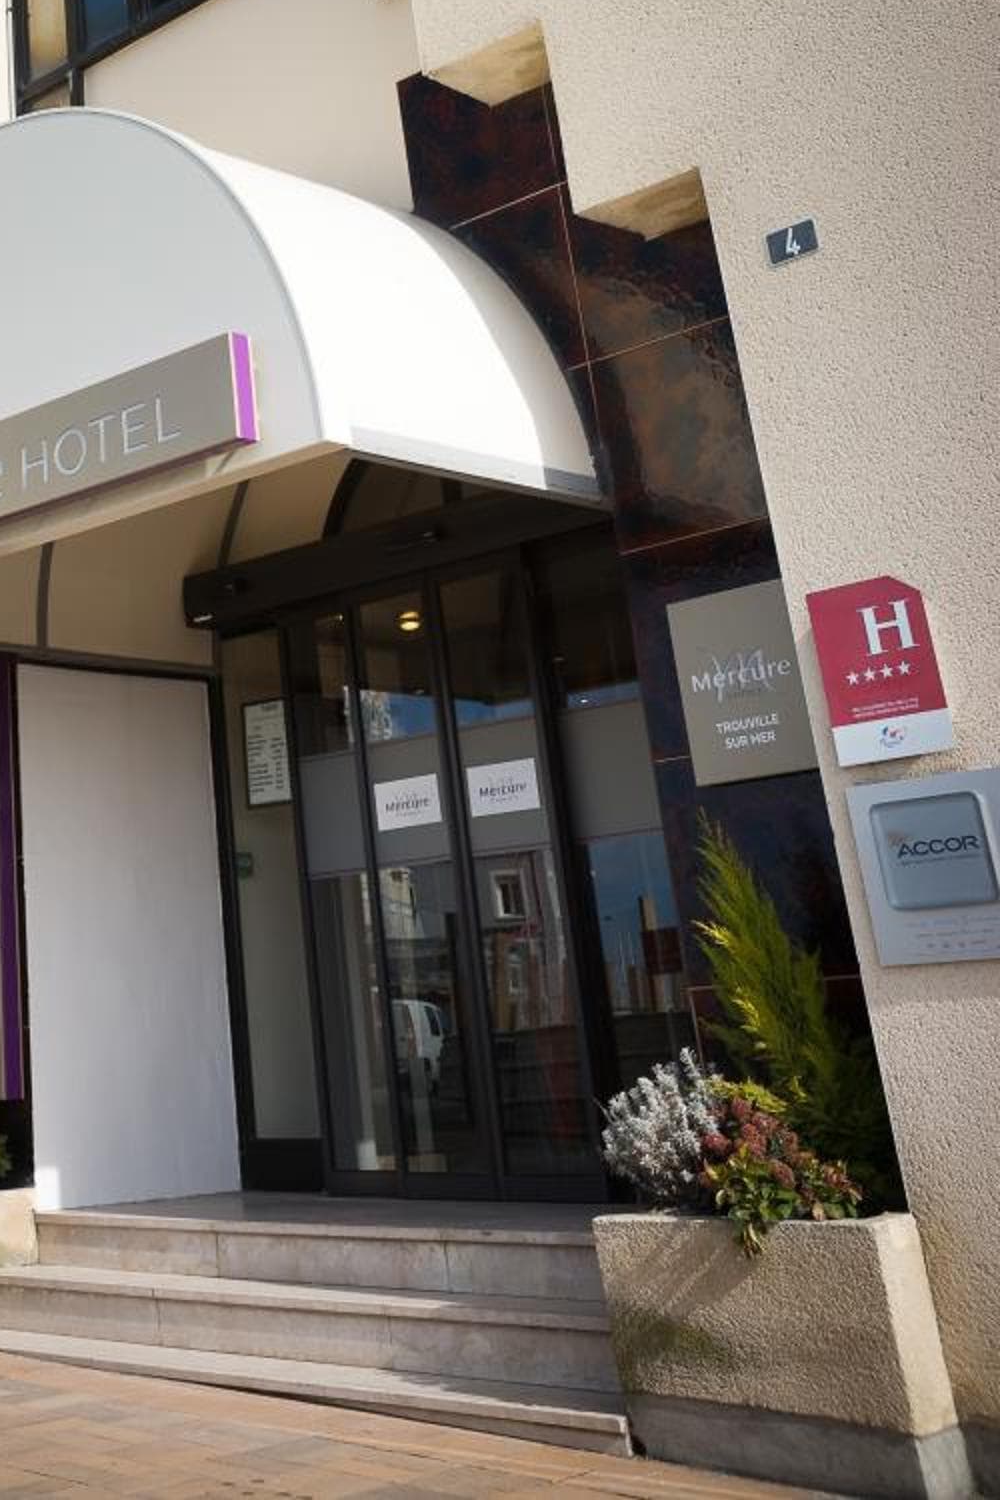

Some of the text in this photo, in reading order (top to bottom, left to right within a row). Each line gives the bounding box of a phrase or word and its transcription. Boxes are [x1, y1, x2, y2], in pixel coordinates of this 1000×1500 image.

[785, 227, 801, 255] 4
[20, 396, 182, 488] HOTEL
[856, 597, 920, 657] H
[691, 658, 791, 694] Mercure
[715, 712, 780, 735] TROUVILLE
[725, 730, 777, 749] SUR MER
[897, 835, 981, 859] ACCOR
